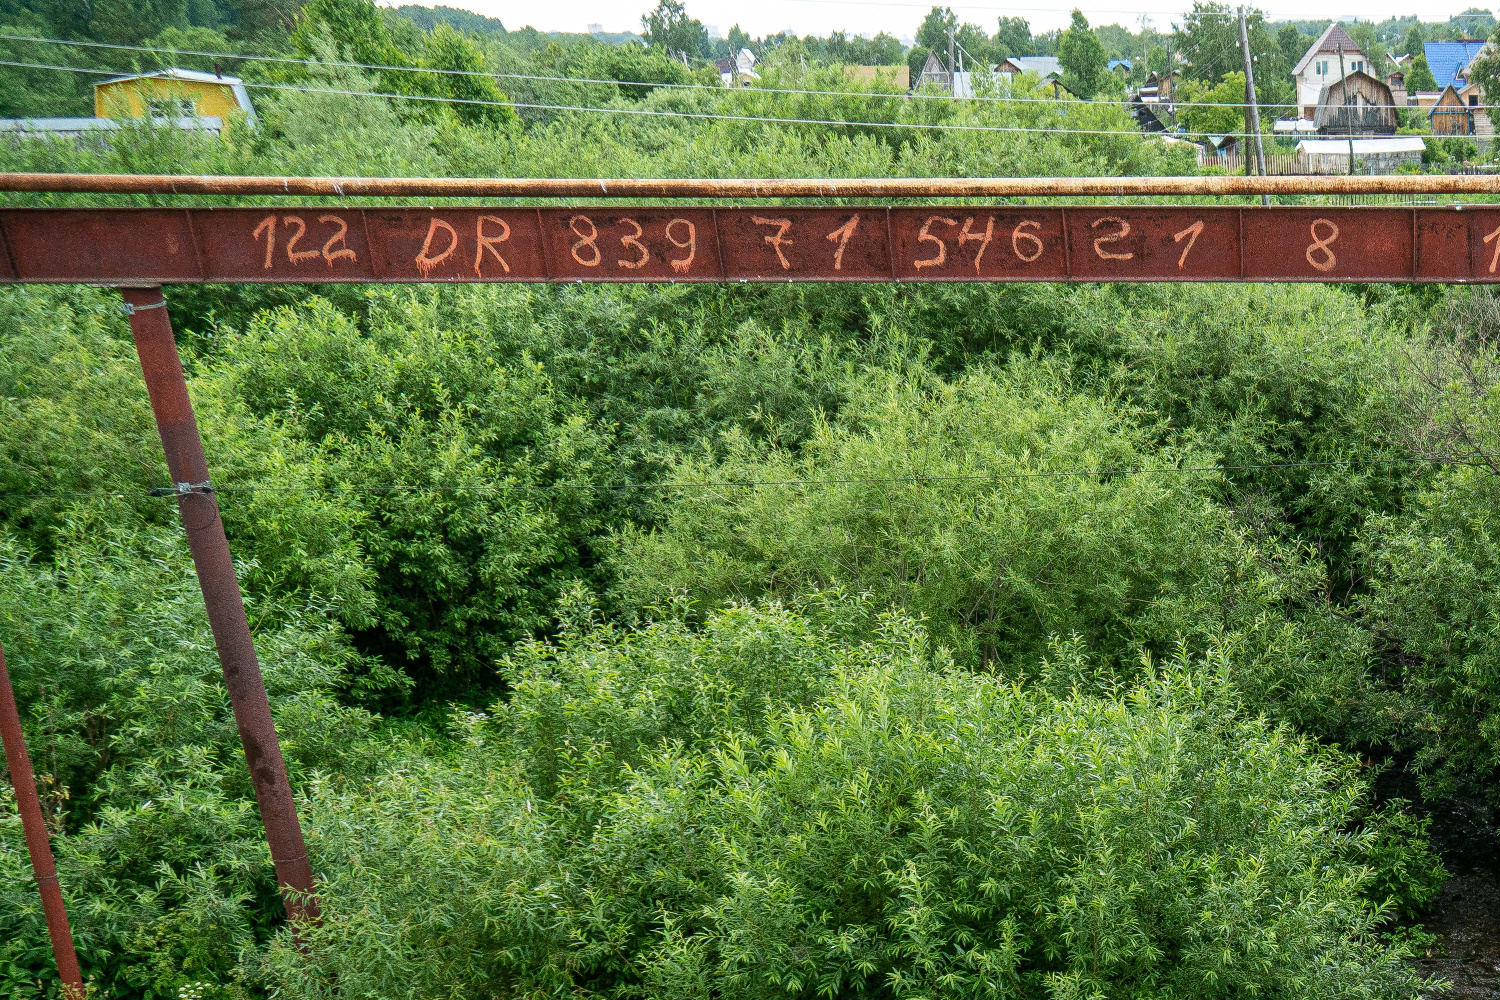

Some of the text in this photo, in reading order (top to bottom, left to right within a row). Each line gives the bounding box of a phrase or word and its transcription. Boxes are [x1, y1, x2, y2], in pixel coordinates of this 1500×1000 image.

[253, 215, 356, 268] 122
[416, 217, 510, 277] DR
[570, 217, 696, 270] 839
[913, 216, 1043, 273] 546
[1306, 218, 1338, 271] 8
